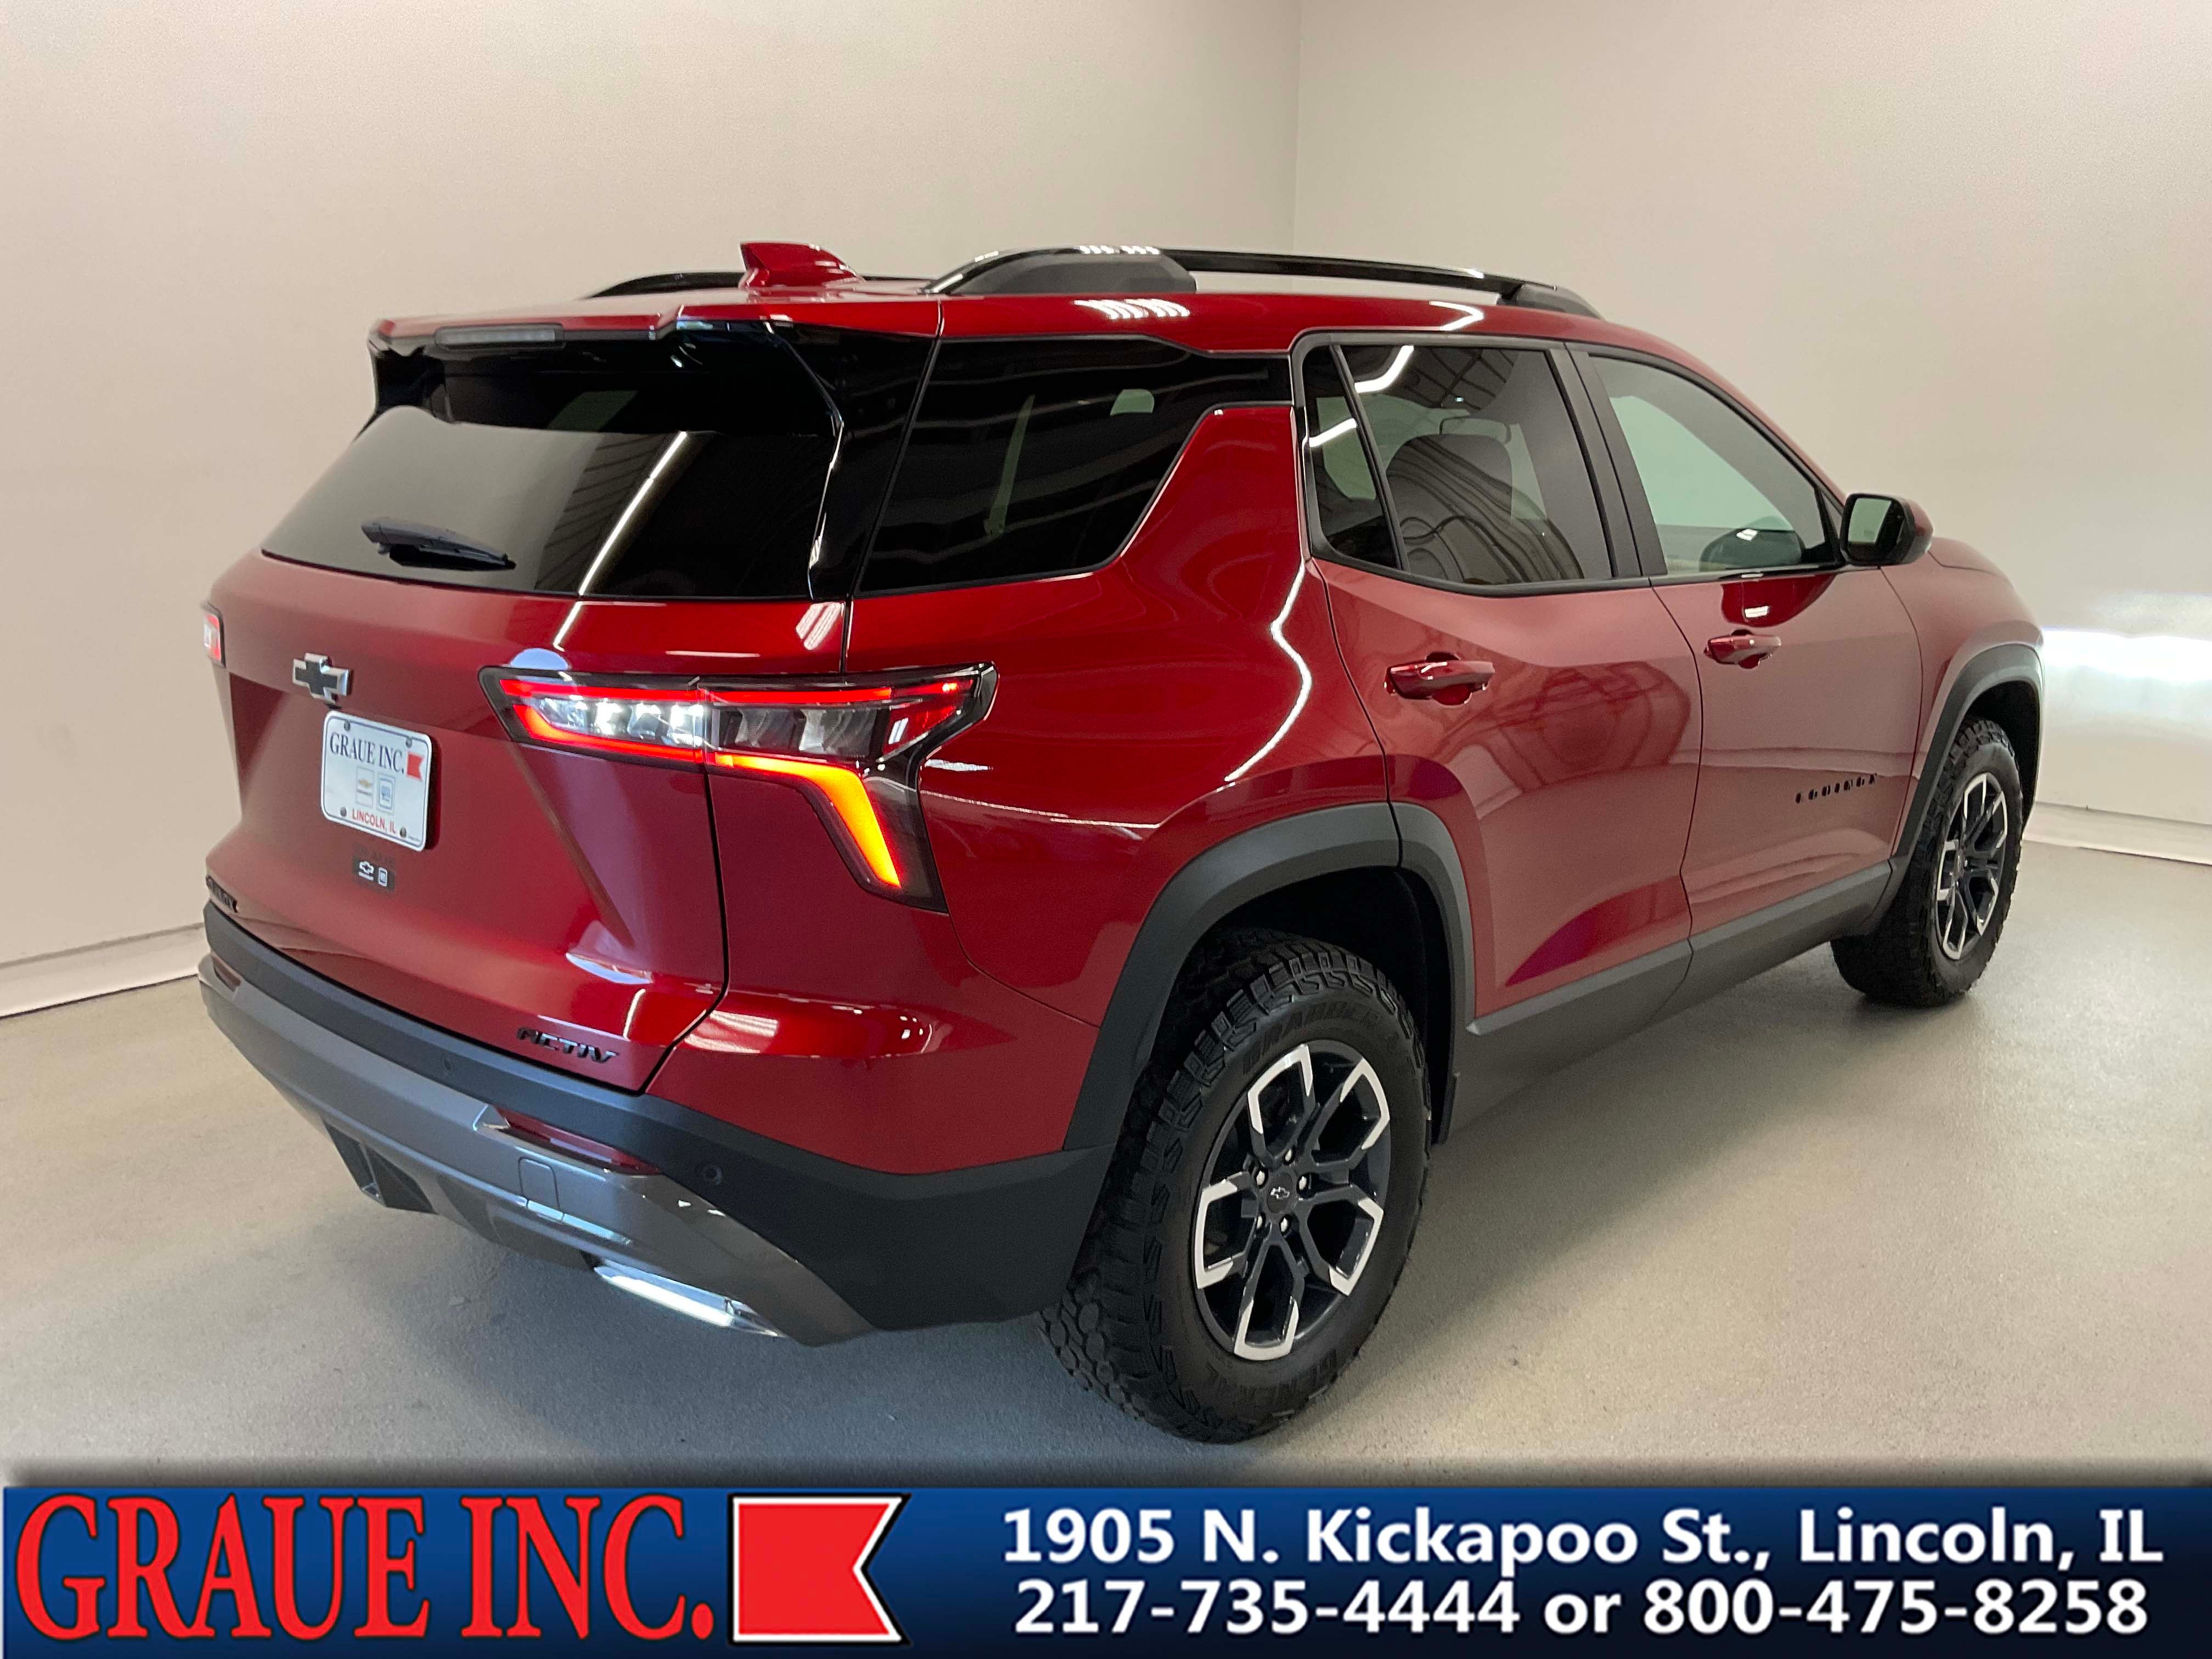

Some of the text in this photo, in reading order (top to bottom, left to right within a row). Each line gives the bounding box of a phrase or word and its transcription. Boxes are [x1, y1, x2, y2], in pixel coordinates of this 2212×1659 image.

[330, 731, 404, 774] GRAUE INC.
[352, 808, 396, 834] LINCOLN, IL
